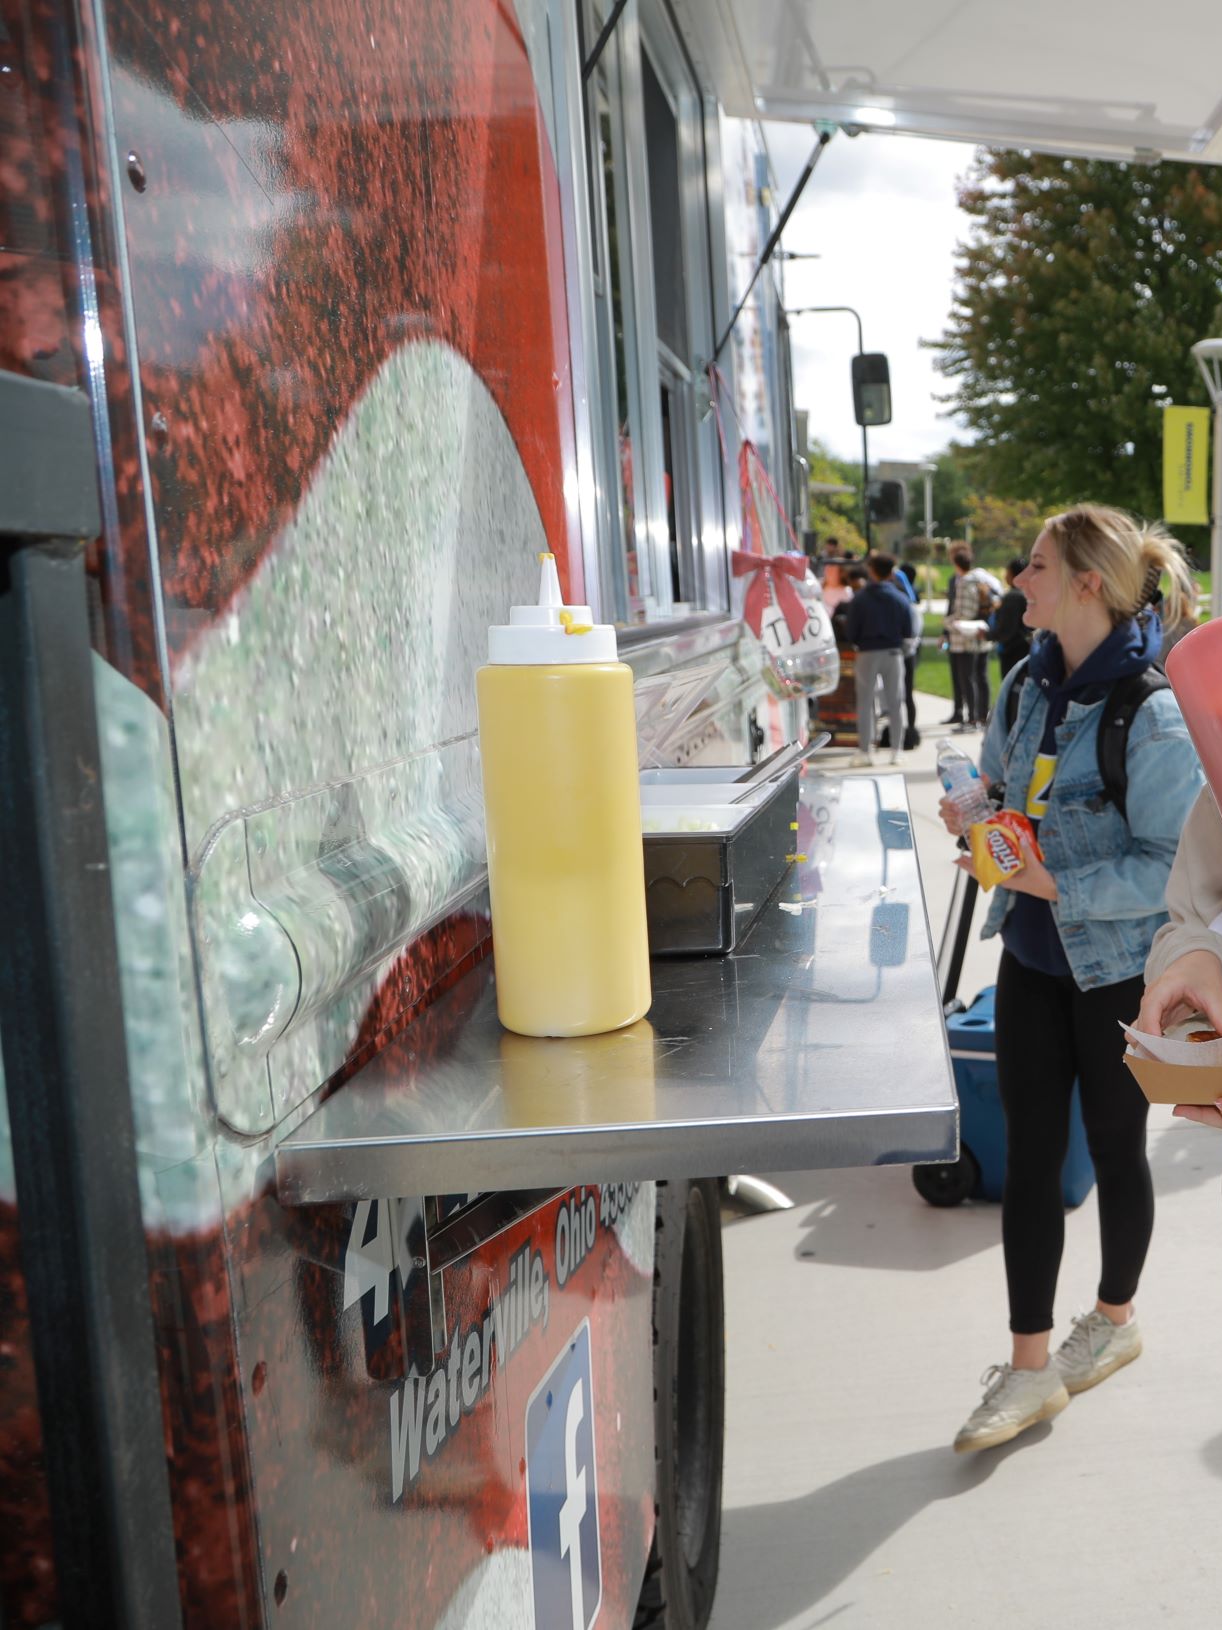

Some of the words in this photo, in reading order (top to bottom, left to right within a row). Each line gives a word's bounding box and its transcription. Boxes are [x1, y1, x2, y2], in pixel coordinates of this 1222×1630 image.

[764, 606, 822, 648] TS
[987, 830, 1021, 875] Fritos
[390, 1241, 549, 1504] Waterville,
[555, 1186, 596, 1286] Ohio
